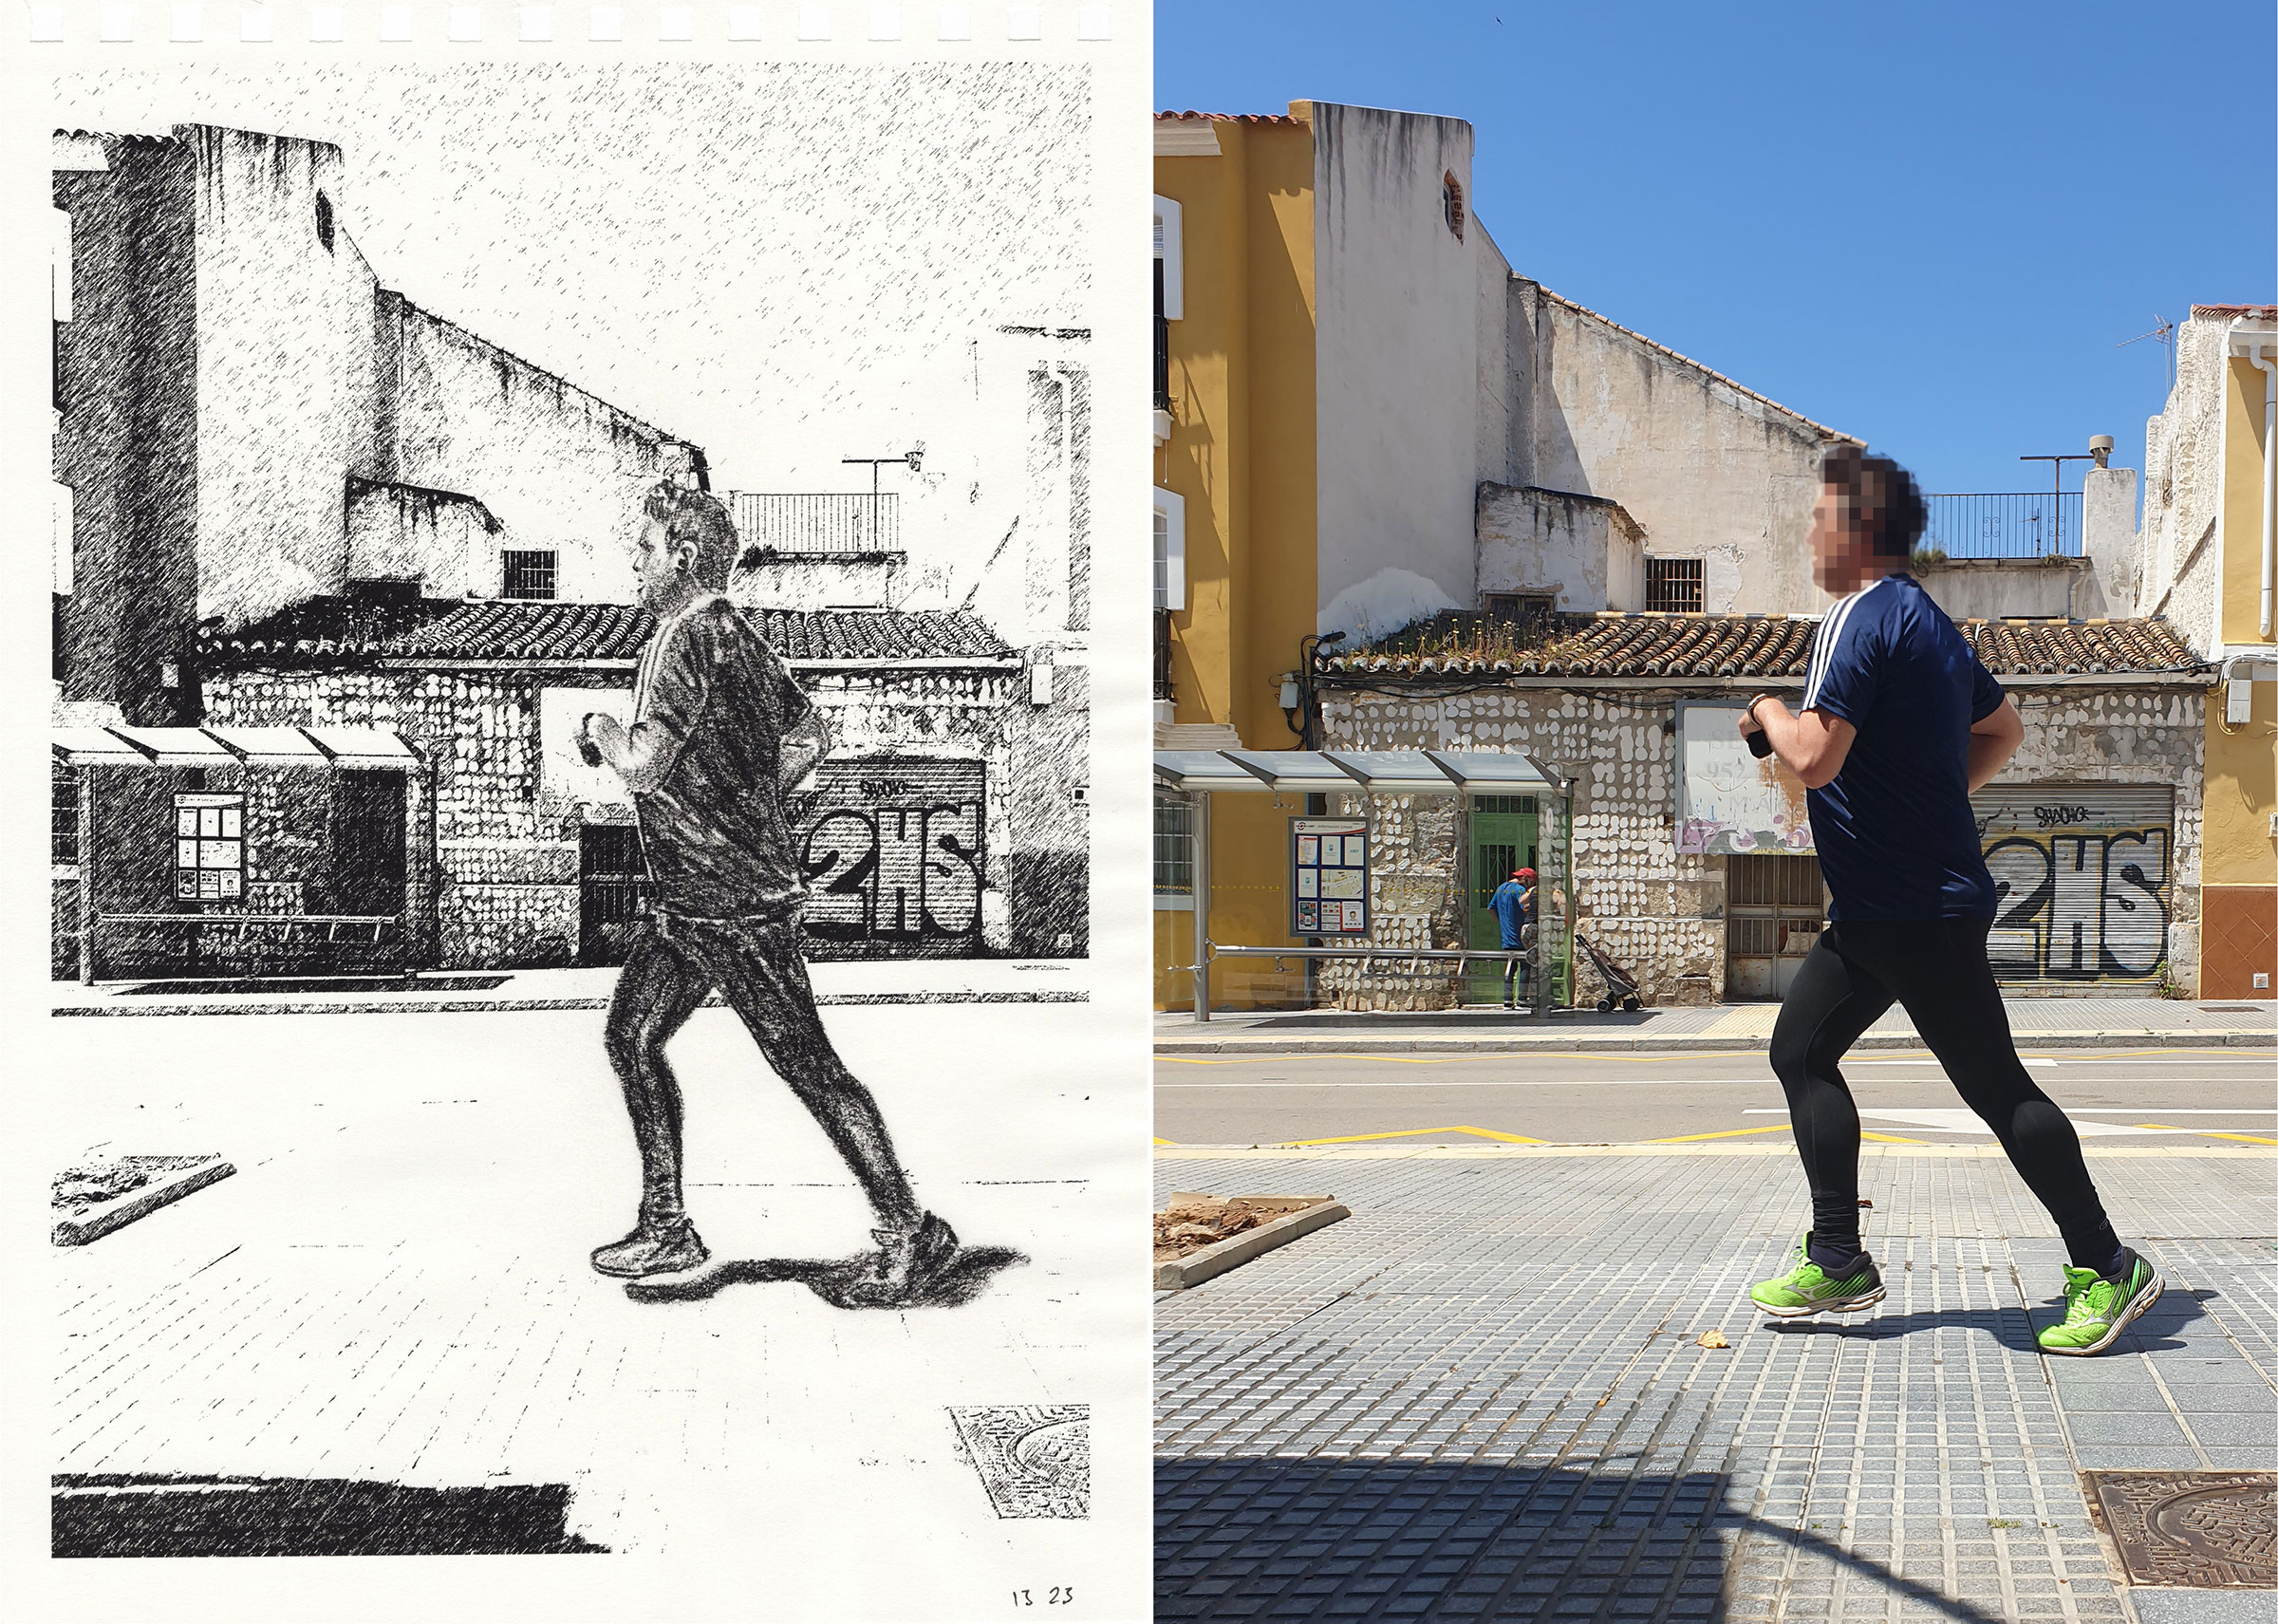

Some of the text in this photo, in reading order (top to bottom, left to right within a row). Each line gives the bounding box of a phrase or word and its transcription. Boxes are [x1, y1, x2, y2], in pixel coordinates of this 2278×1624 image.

[801, 802, 984, 941] 2HS
[1013, 1587, 1073, 1607] 13 23
